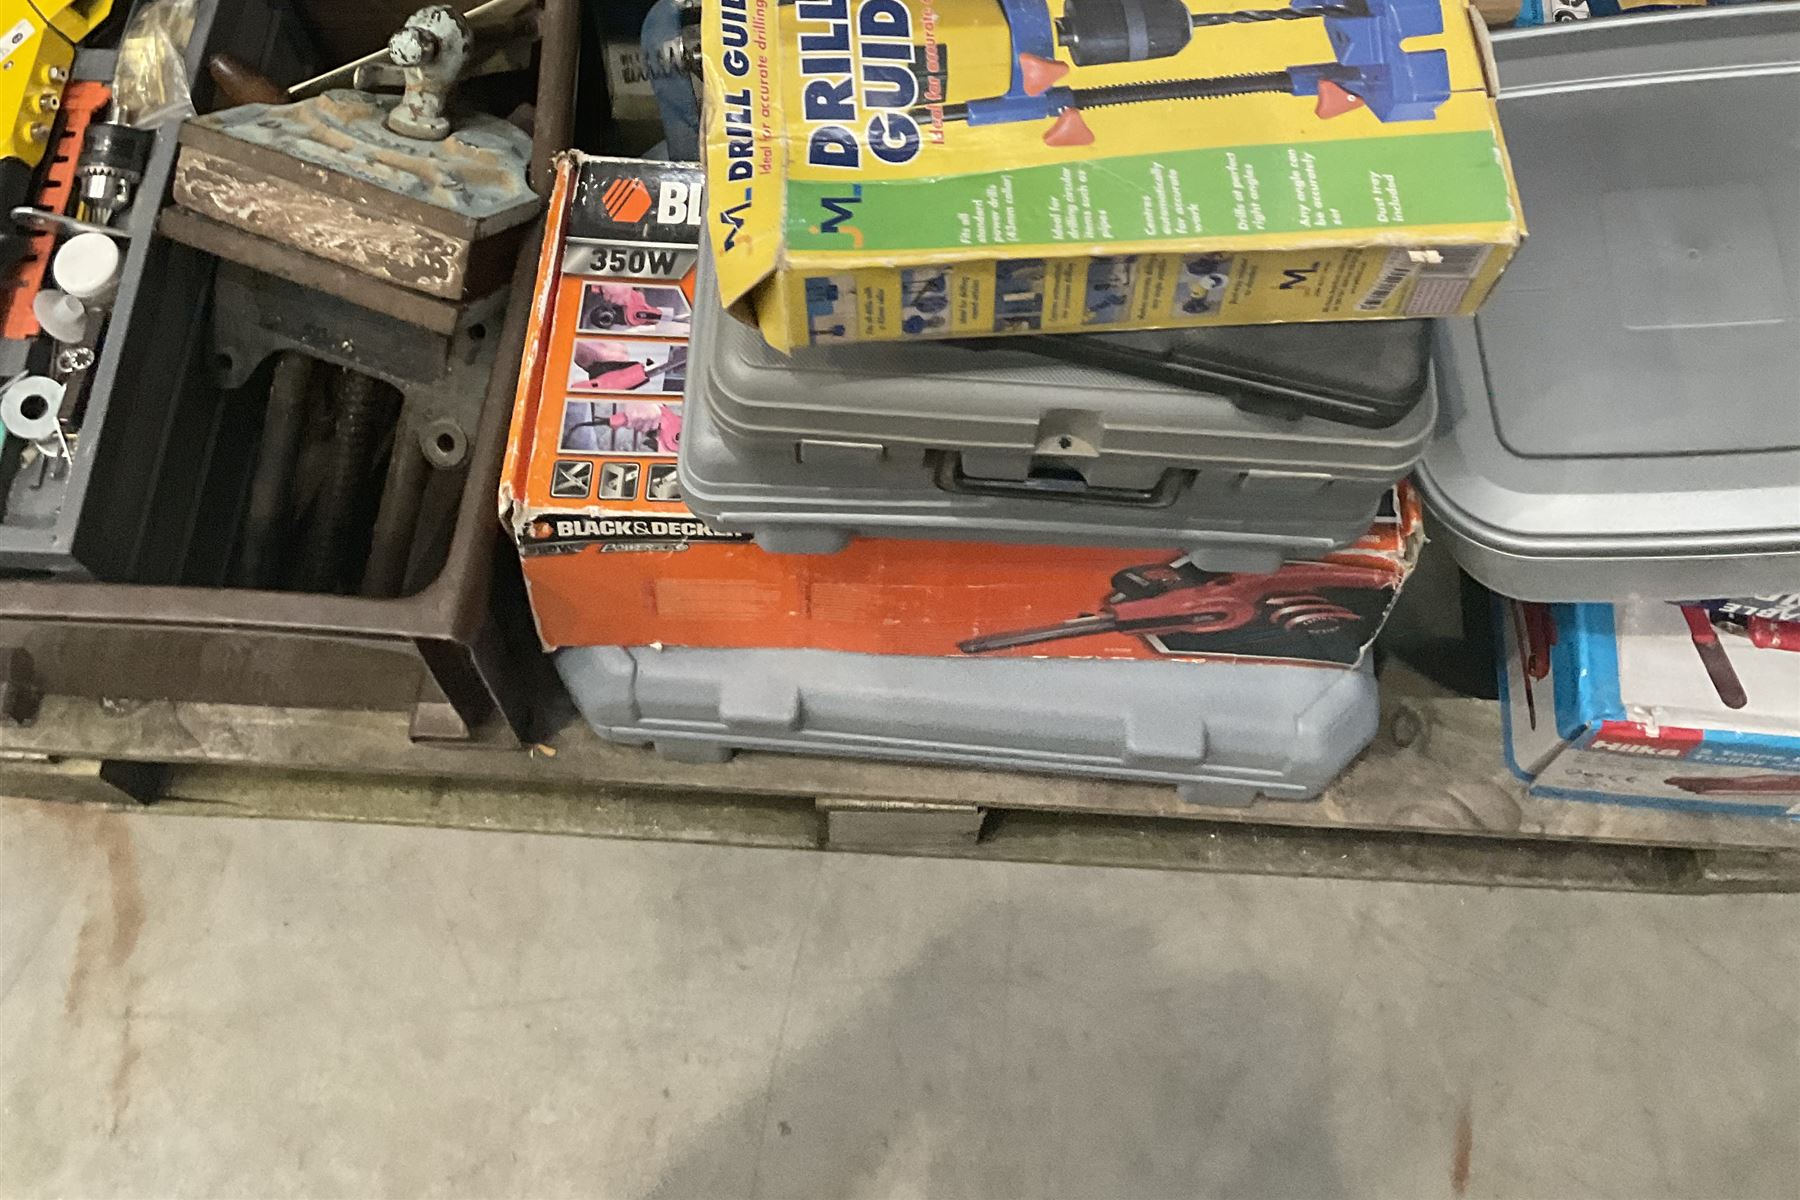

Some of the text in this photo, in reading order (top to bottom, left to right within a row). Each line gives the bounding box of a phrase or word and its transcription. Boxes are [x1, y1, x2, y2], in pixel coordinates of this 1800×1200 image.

[757, 55, 771, 118] accurate
[922, 77, 942, 100] for
[723, 88, 753, 182] DRILL
[923, 105, 945, 145] Ideal
[758, 146, 773, 175] Ideal
[1224, 152, 1244, 189] perfect
[1079, 185, 1091, 208] such
[1167, 169, 1188, 234] for accurate
[1243, 163, 1266, 230] right angles
[1285, 149, 1312, 228] Any angle can
[1301, 152, 1327, 227] be accurately
[1367, 170, 1389, 223] Dust tray
[1382, 174, 1404, 222] included
[957, 212, 971, 244] Fits all
[972, 199, 987, 243] standard
[987, 185, 1004, 242] power drills
[1047, 195, 1065, 240] Ideal for
[1065, 204, 1080, 239] drilling
[1083, 211, 1095, 239] items
[1097, 210, 1113, 239] pipes
[1141, 195, 1157, 236] Centres
[1186, 203, 1203, 233] work
[1328, 208, 1343, 225] set
[589, 249, 680, 276] 350W
[556, 519, 744, 538] BLACK&DECK
